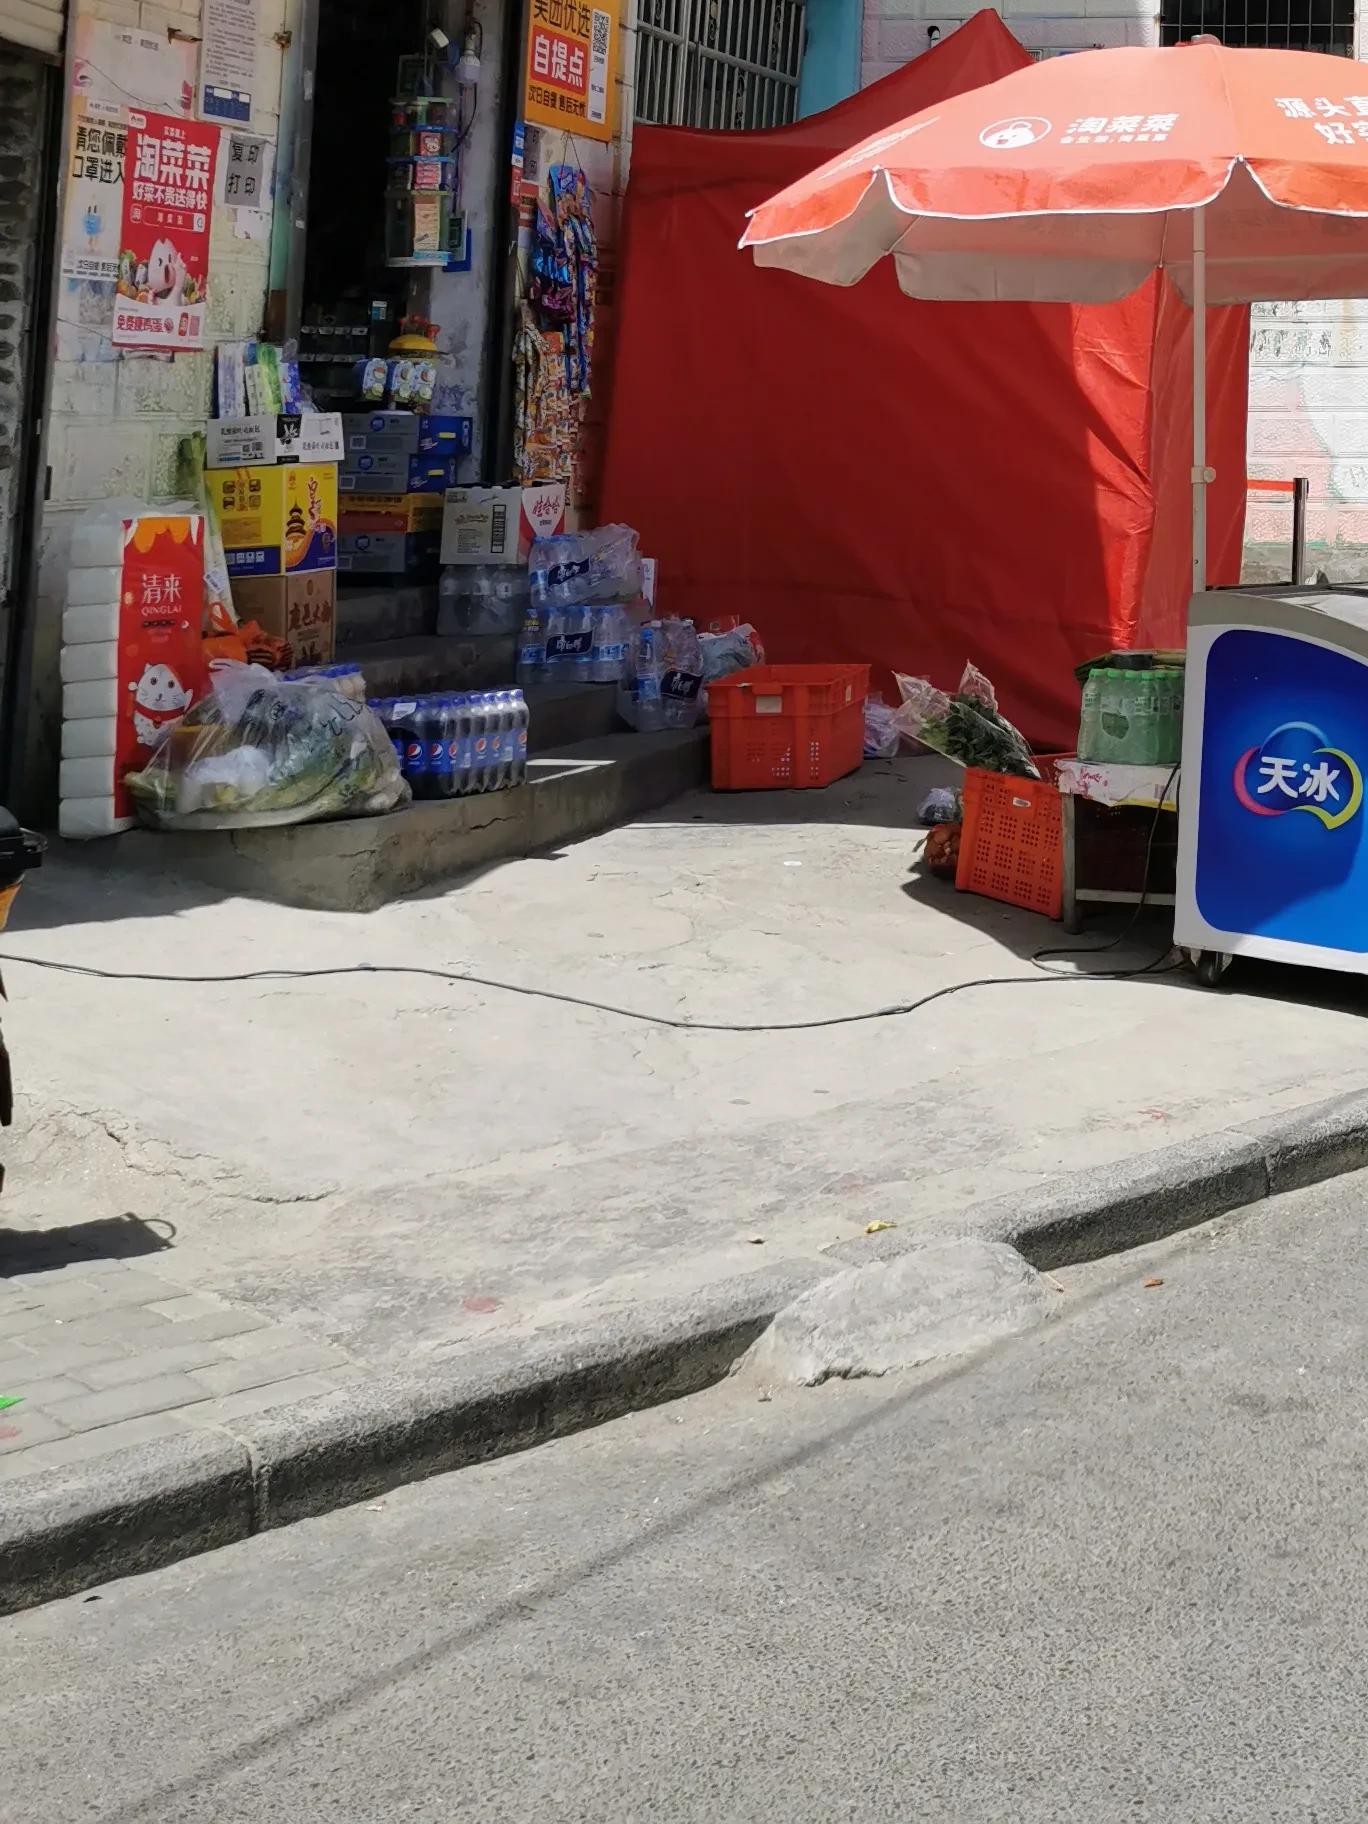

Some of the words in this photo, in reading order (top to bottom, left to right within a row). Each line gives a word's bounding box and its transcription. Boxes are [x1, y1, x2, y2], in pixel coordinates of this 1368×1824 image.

[533, 34, 583, 88] 自提点
[1066, 113, 1180, 134] 淘菜菜
[134, 133, 211, 190] 淘菜菜
[231, 141, 260, 164] 复印
[72, 154, 126, 183] 口罩进入
[132, 180, 207, 210] 好菜不贵送得快
[227, 173, 256, 195] 打印
[141, 573, 183, 604] 清来
[141, 604, 182, 616] QINGLAI
[1257, 756, 1340, 802] 天冰
